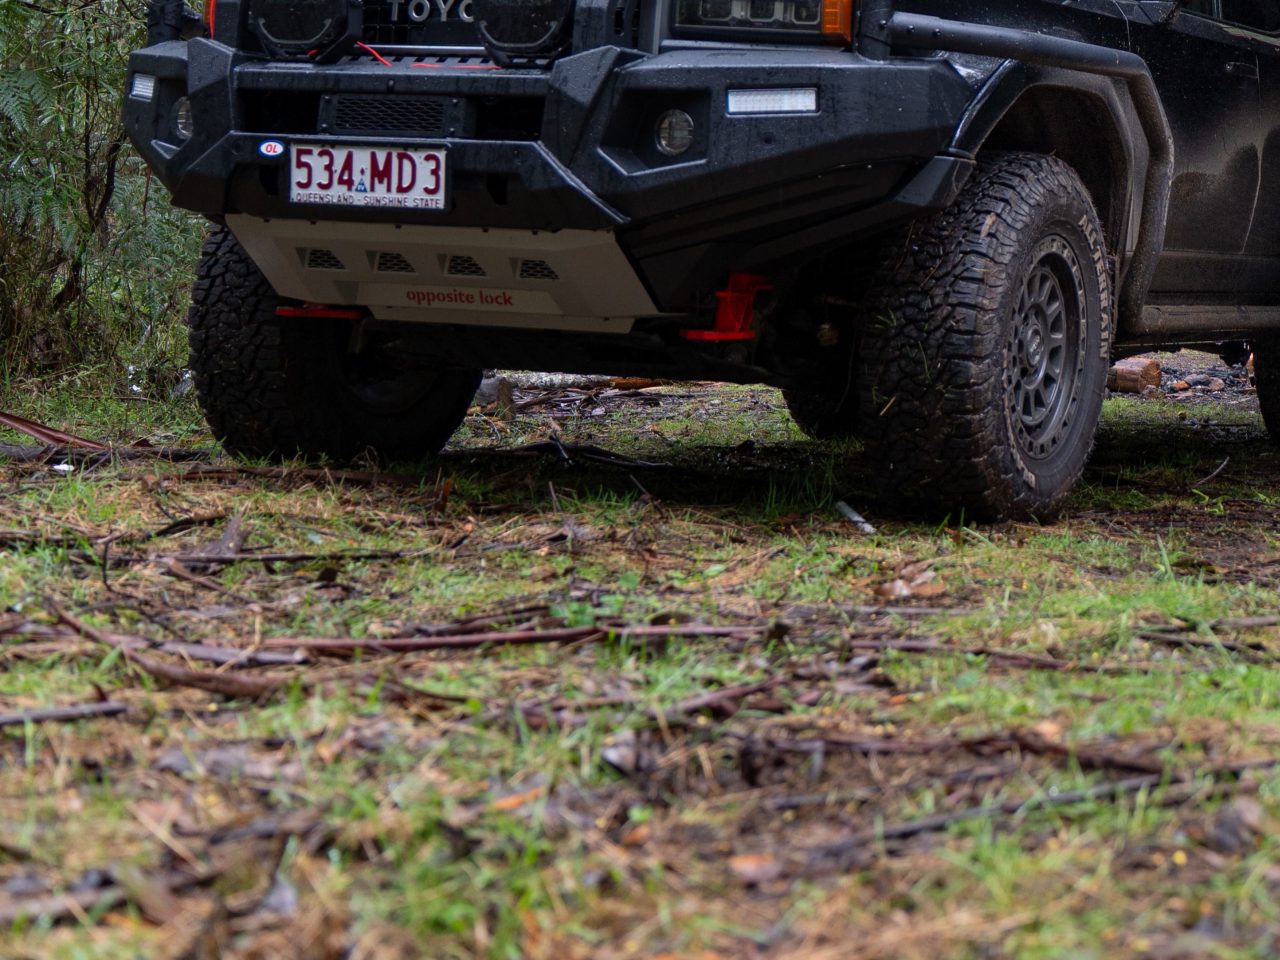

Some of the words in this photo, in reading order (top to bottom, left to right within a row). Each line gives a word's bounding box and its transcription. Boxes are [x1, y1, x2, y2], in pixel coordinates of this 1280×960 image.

[266, 144, 278, 153] OL
[296, 193, 354, 204] QUEENSLAND
[364, 195, 408, 207] SUNSHINE
[413, 197, 441, 208] STATE
[1078, 214, 1097, 249] ALL
[1093, 246, 1109, 358] TERRAIN
[407, 289, 475, 305] opposite
[480, 291, 513, 306] lock
